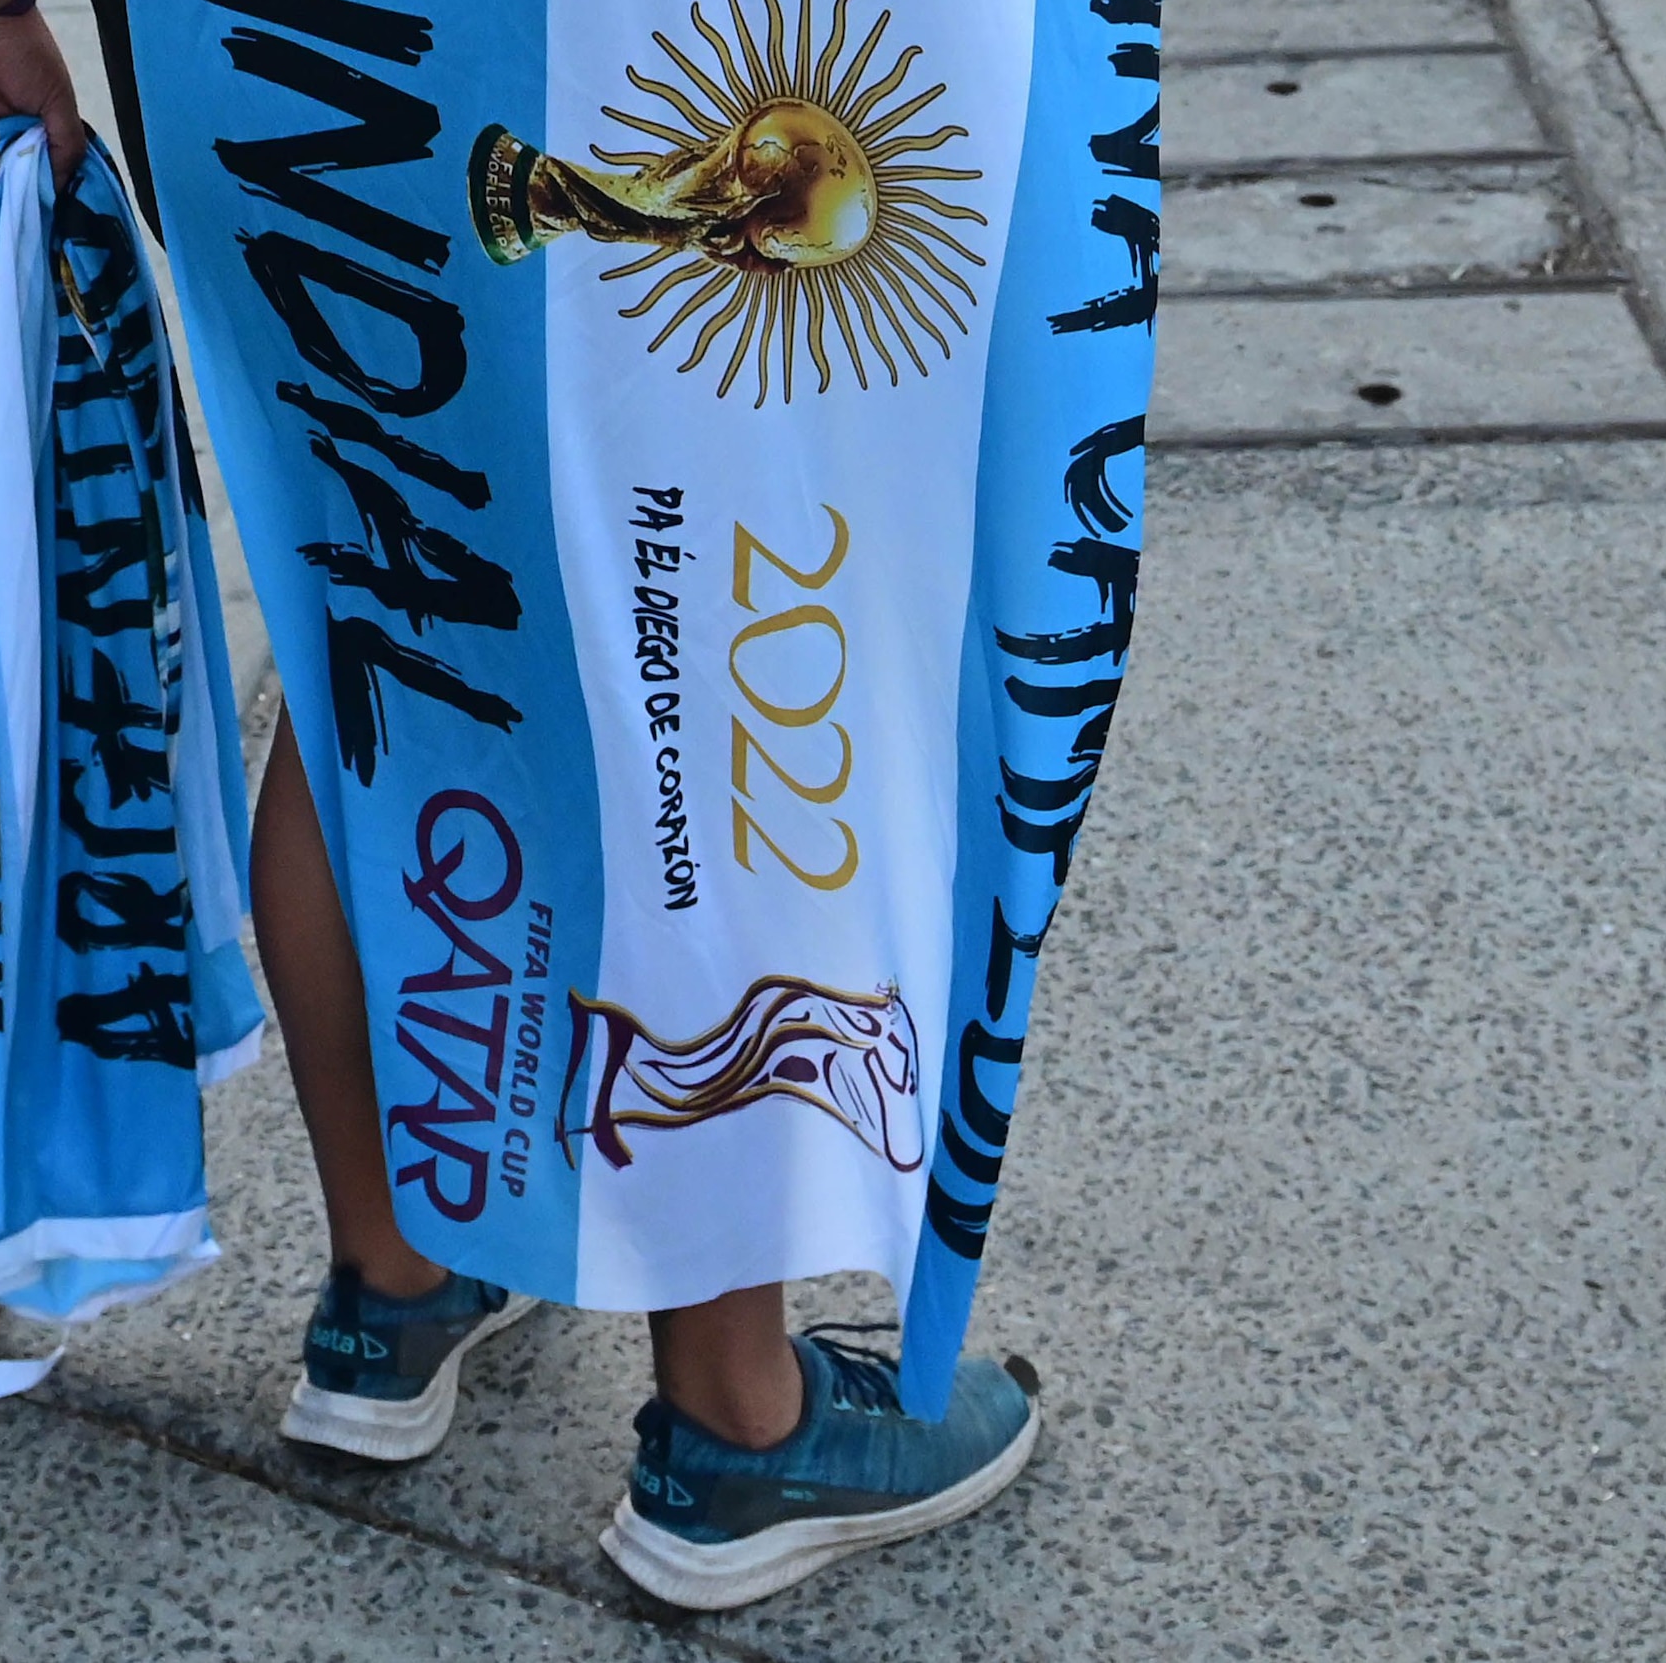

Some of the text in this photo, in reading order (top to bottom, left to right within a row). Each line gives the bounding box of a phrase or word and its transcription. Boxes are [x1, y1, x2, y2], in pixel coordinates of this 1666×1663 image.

[485, 147, 508, 248] WORLD CUP
[498, 161, 515, 228] FIFA
[628, 486, 685, 533] PA
[631, 585, 681, 682] DIEGO
[643, 691, 681, 742] DE
[729, 503, 859, 892] 2022
[654, 746, 701, 912] CORAZÓN
[388, 788, 524, 1224] QATAR
[499, 899, 554, 1199] FIFA WORLD CUP
